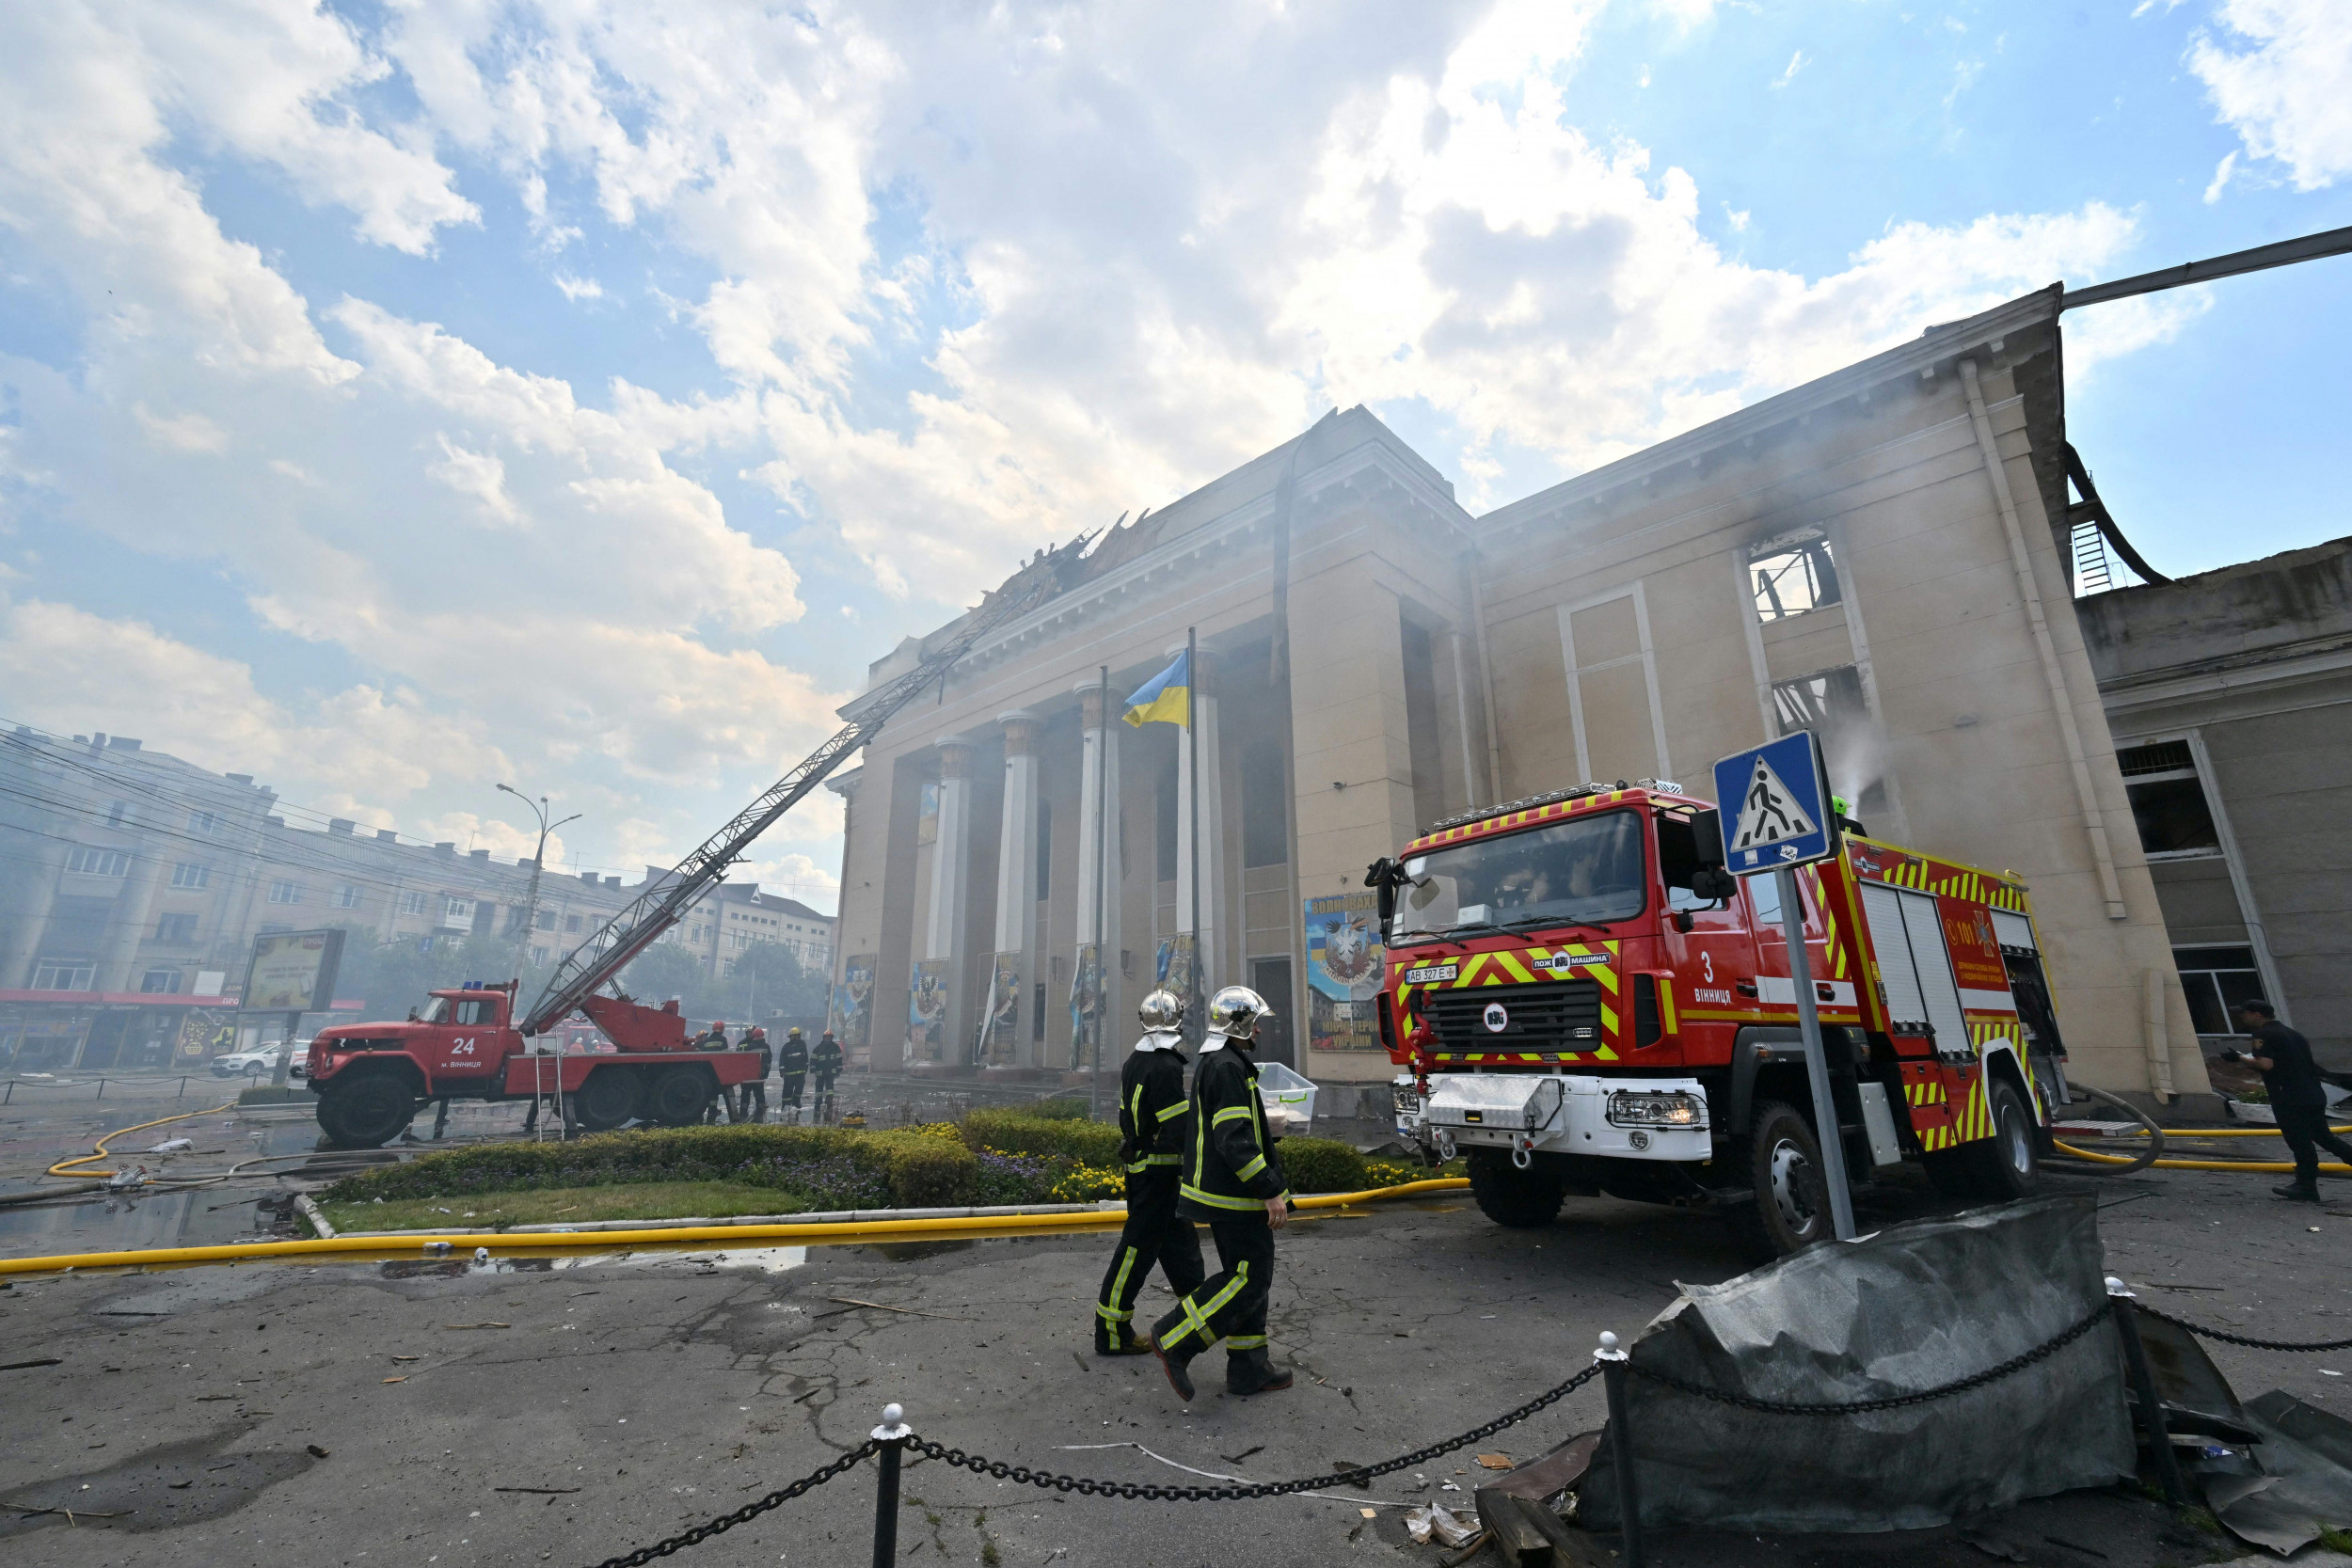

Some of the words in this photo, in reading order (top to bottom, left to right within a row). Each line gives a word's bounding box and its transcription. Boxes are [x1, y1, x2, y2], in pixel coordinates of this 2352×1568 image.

[1311, 895, 1377, 914] ВОЛНОВАХА
[1957, 921, 1975, 945] 101
[1571, 955, 1607, 964] МАШИНА
[1701, 951, 1713, 983] 3
[1411, 971, 1421, 981] AB
[1423, 969, 1437, 980] 327
[1439, 968, 1445, 978] E
[1694, 988, 1731, 1006] ВІННИЦЯ
[452, 1037, 475, 1054] 24
[1332, 1033, 1372, 1047] УКРАЇНИ
